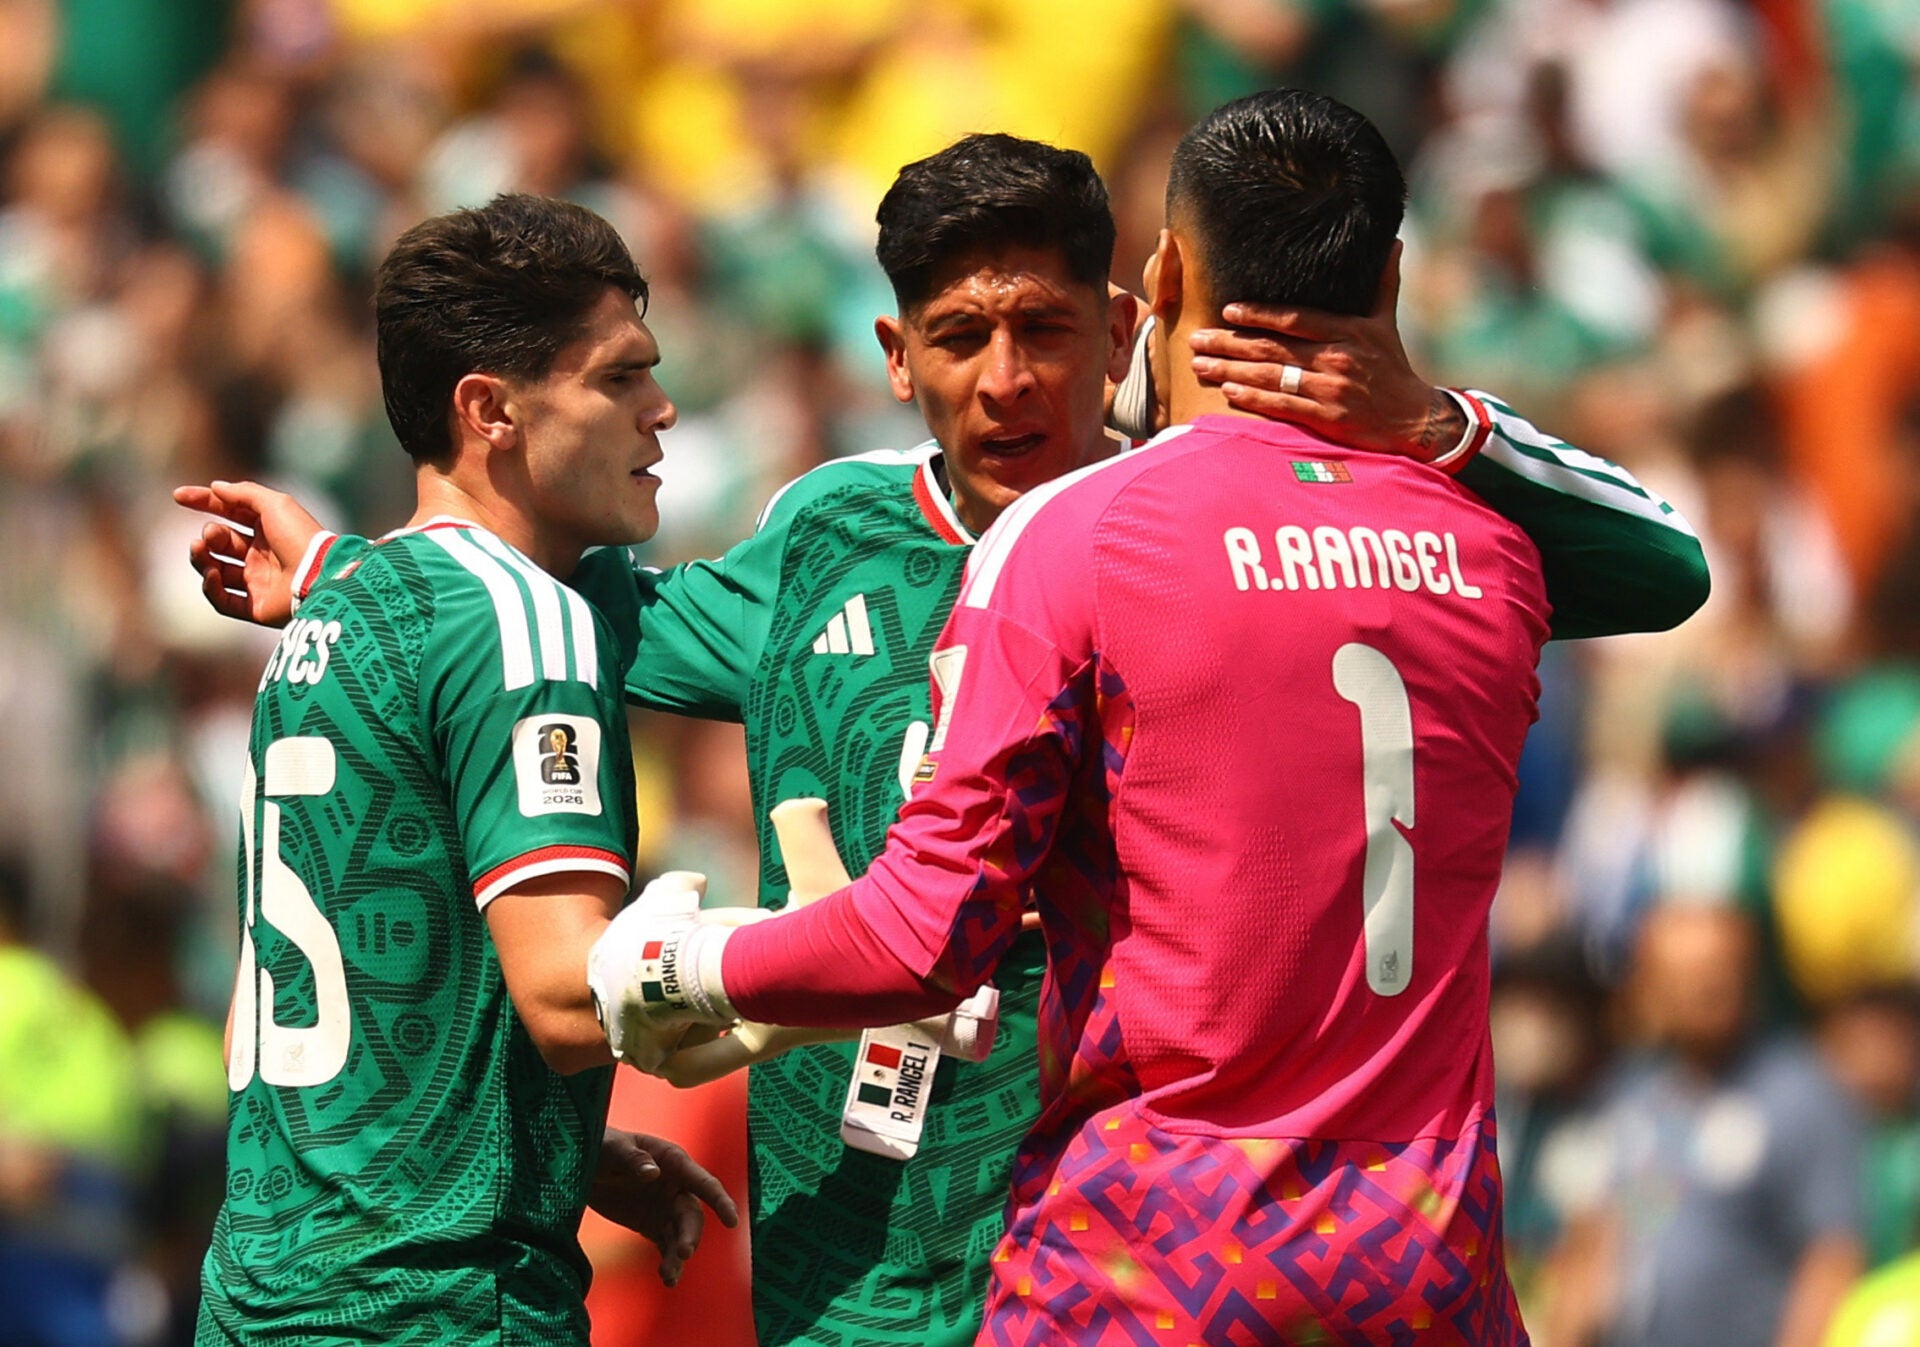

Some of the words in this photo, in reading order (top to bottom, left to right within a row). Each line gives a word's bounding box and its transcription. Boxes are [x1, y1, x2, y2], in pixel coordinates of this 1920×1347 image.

[1224, 525, 1483, 600] R.RANGEL
[551, 772, 573, 780] FIFA
[543, 795, 583, 805] 2026
[1332, 642, 1415, 997] 1
[662, 937, 682, 995] RANGEL
[906, 1041, 931, 1051] 1
[893, 1054, 929, 1109] RANGEL
[890, 1110, 915, 1124] R.
